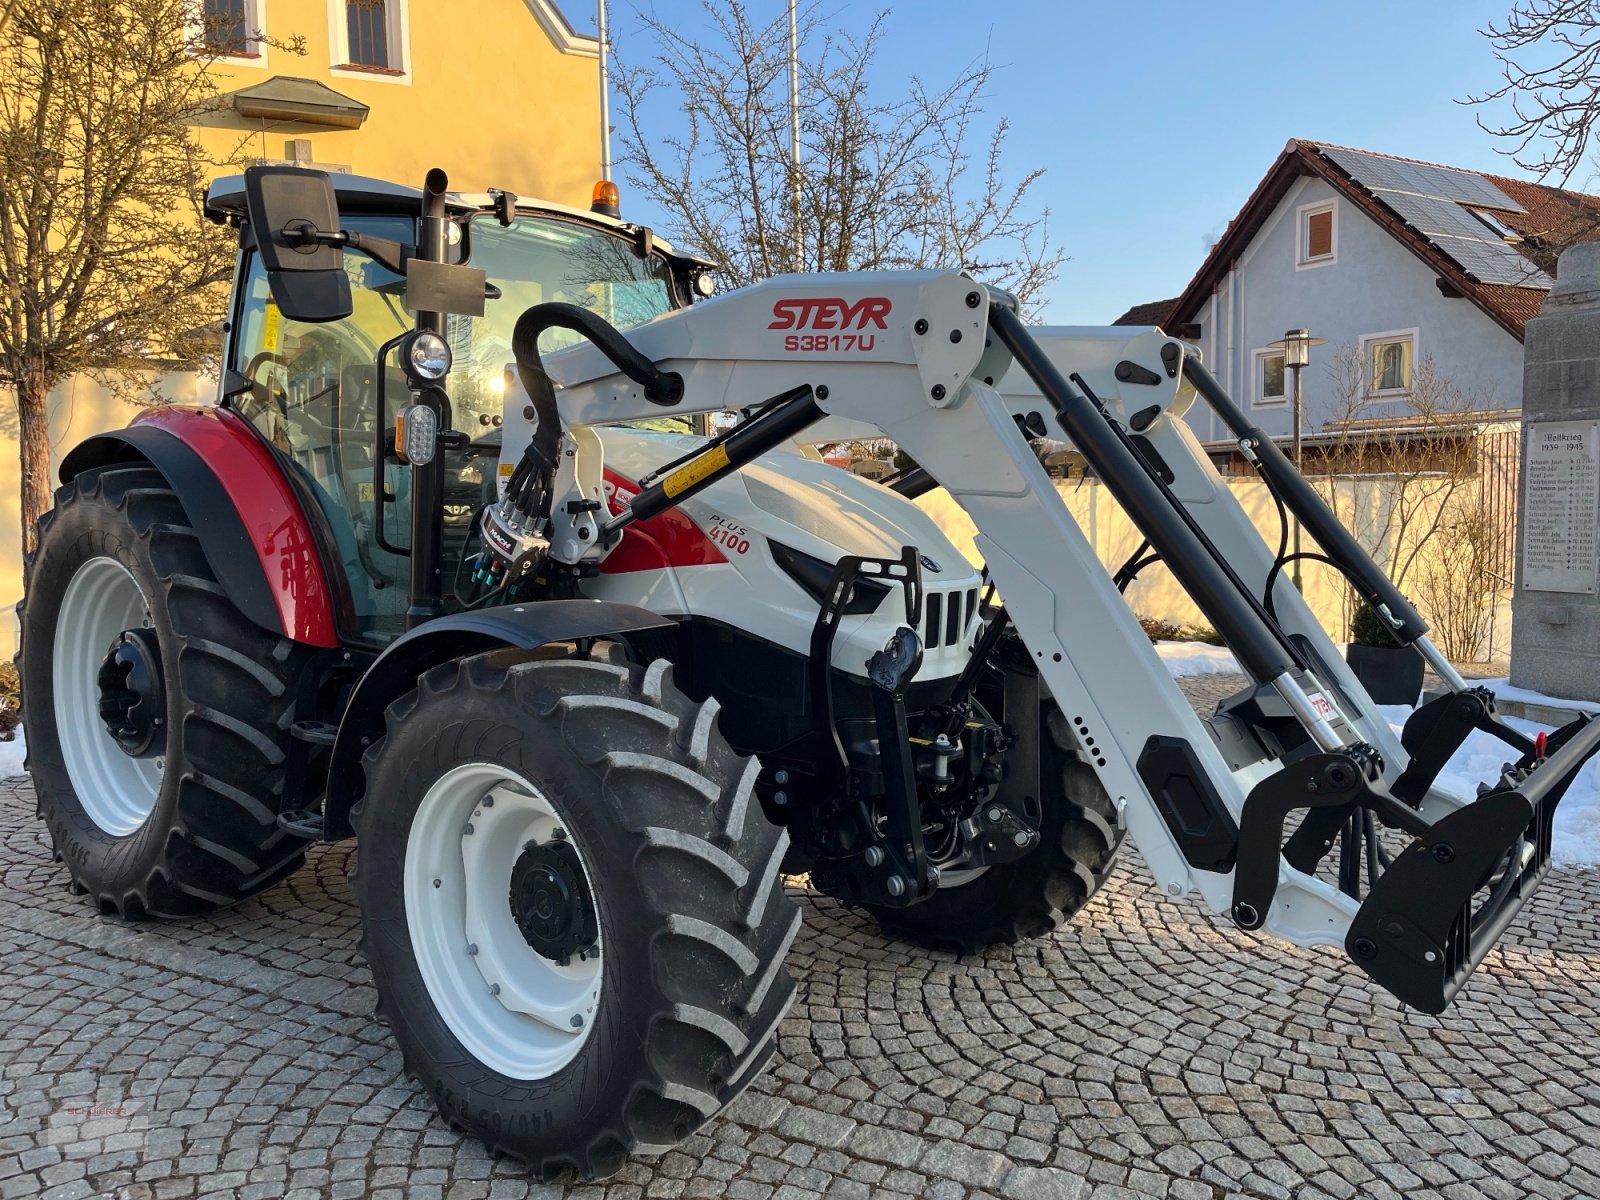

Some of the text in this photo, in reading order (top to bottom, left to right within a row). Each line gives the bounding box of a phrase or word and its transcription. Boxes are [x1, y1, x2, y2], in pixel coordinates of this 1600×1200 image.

[768, 297, 892, 330] STEYR
[784, 334, 875, 352] S3817U
[1541, 443, 1559, 452] 1939
[1566, 442, 1584, 452] 1945
[1543, 433, 1583, 443] Weltkrieg
[709, 514, 748, 536] PLUS
[709, 526, 750, 555] 4100
